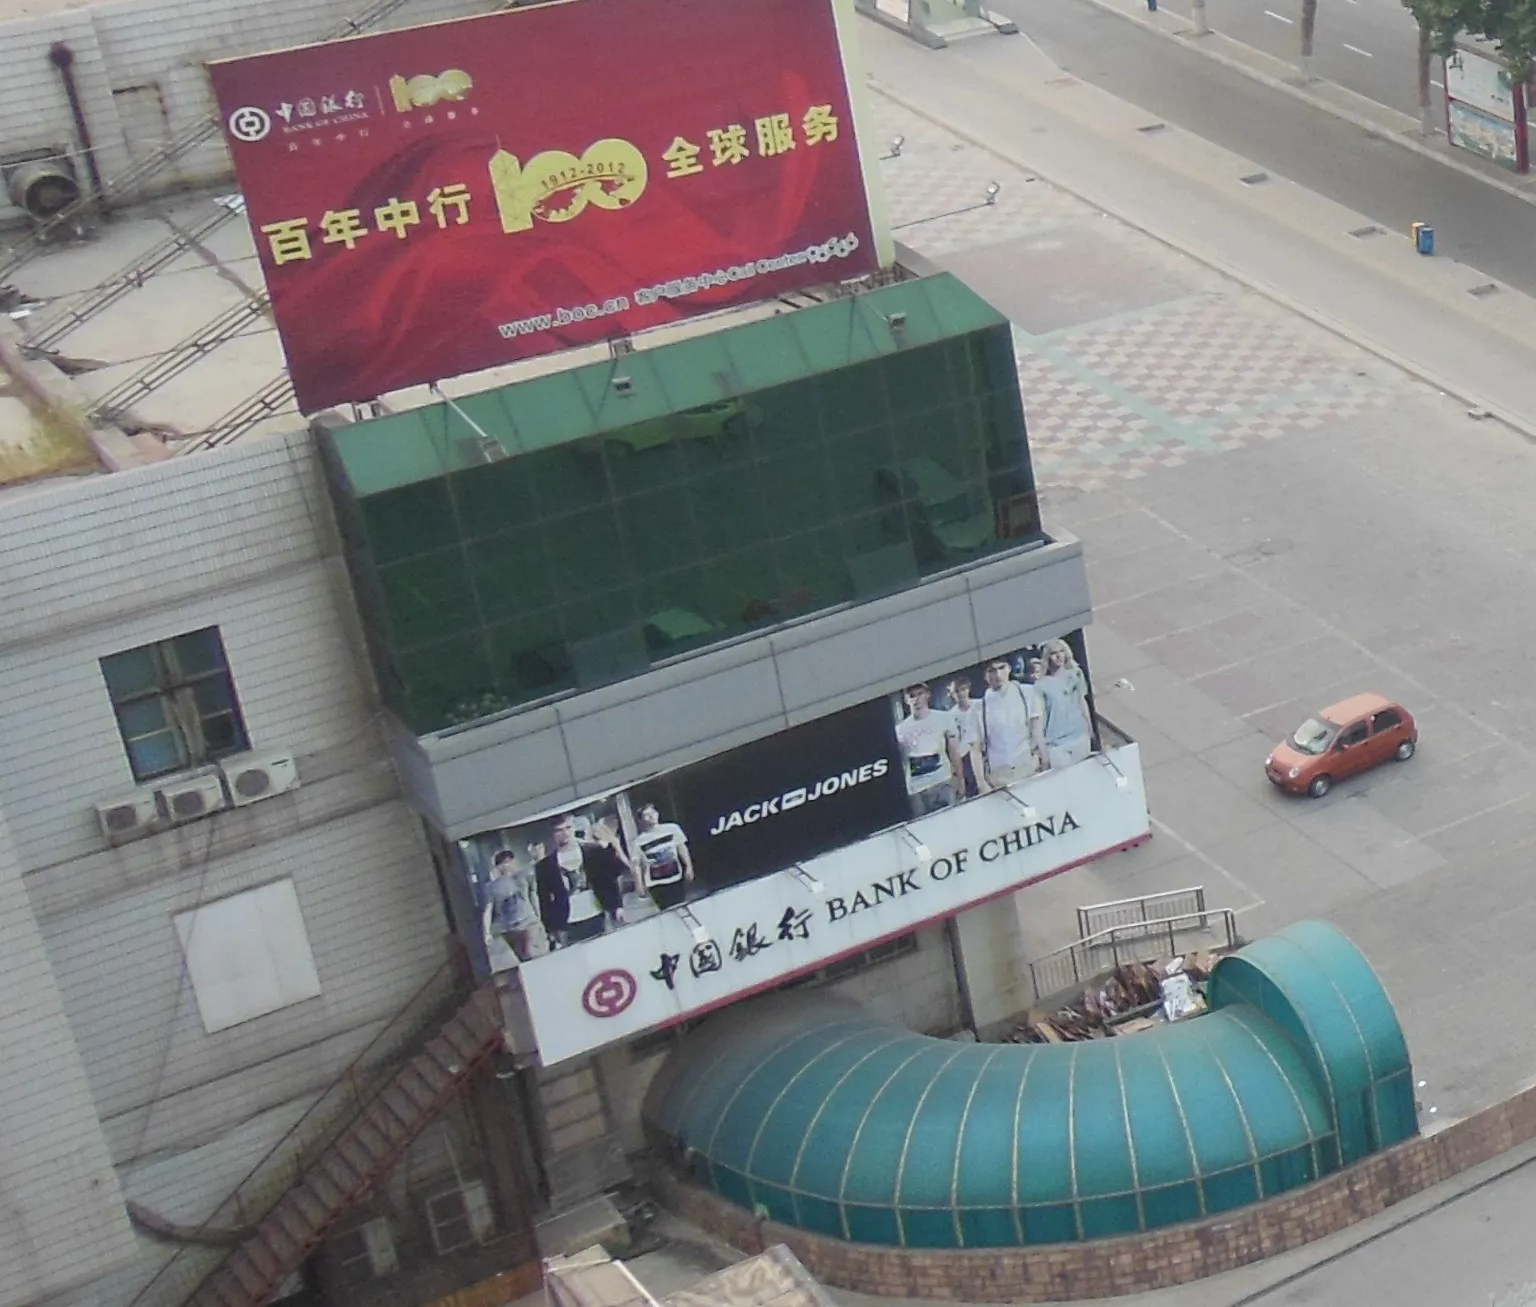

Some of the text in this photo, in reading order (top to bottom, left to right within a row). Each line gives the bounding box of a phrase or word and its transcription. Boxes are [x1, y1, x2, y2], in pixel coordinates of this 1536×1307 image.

[540, 162, 627, 191] 1912-2012
[662, 103, 839, 179] 全球服务
[260, 183, 472, 266] 百年中行
[499, 296, 629, 338] www.boc.cn
[826, 868, 921, 923] BANK
[930, 849, 970, 881] OF
[979, 811, 1081, 862] CHINA
